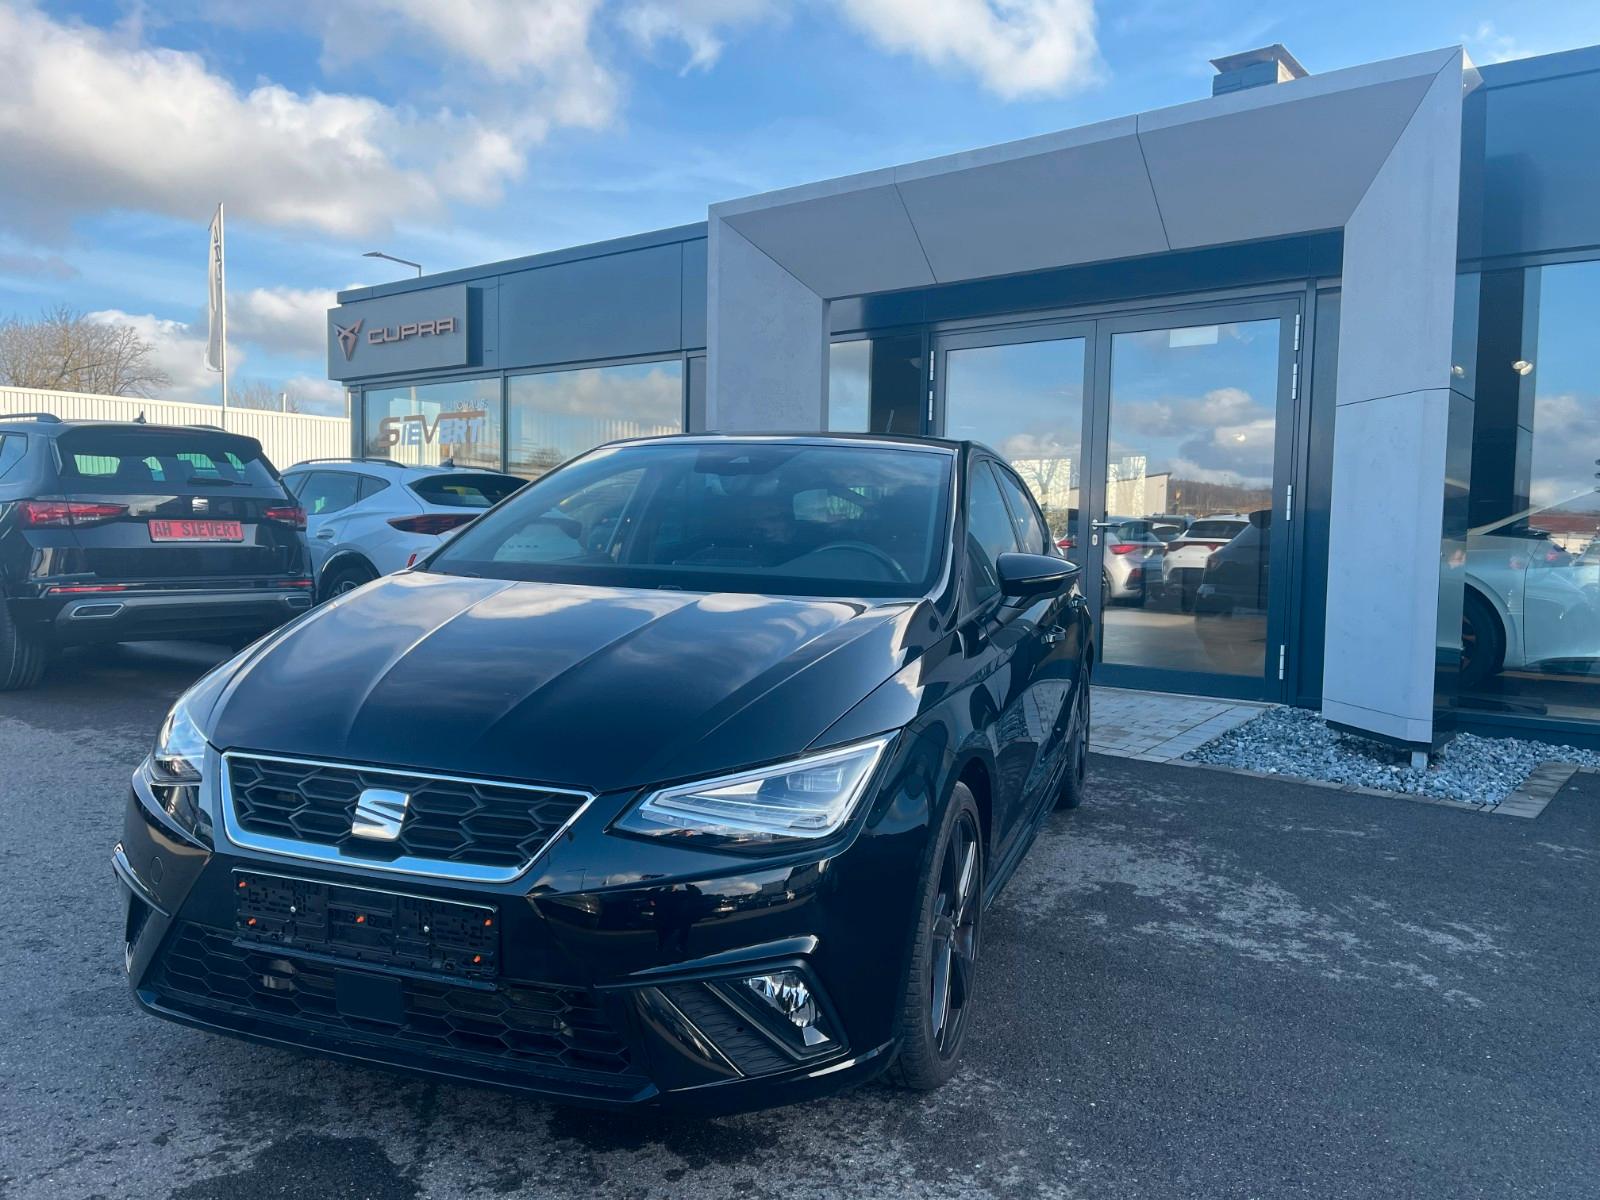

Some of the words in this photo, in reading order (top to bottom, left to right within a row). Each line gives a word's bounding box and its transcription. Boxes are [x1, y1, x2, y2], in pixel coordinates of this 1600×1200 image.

[367, 317, 455, 344] CUPRA
[377, 411, 486, 448] SIEVERT
[153, 521, 172, 537] AH
[182, 521, 240, 537] SIEVERT
